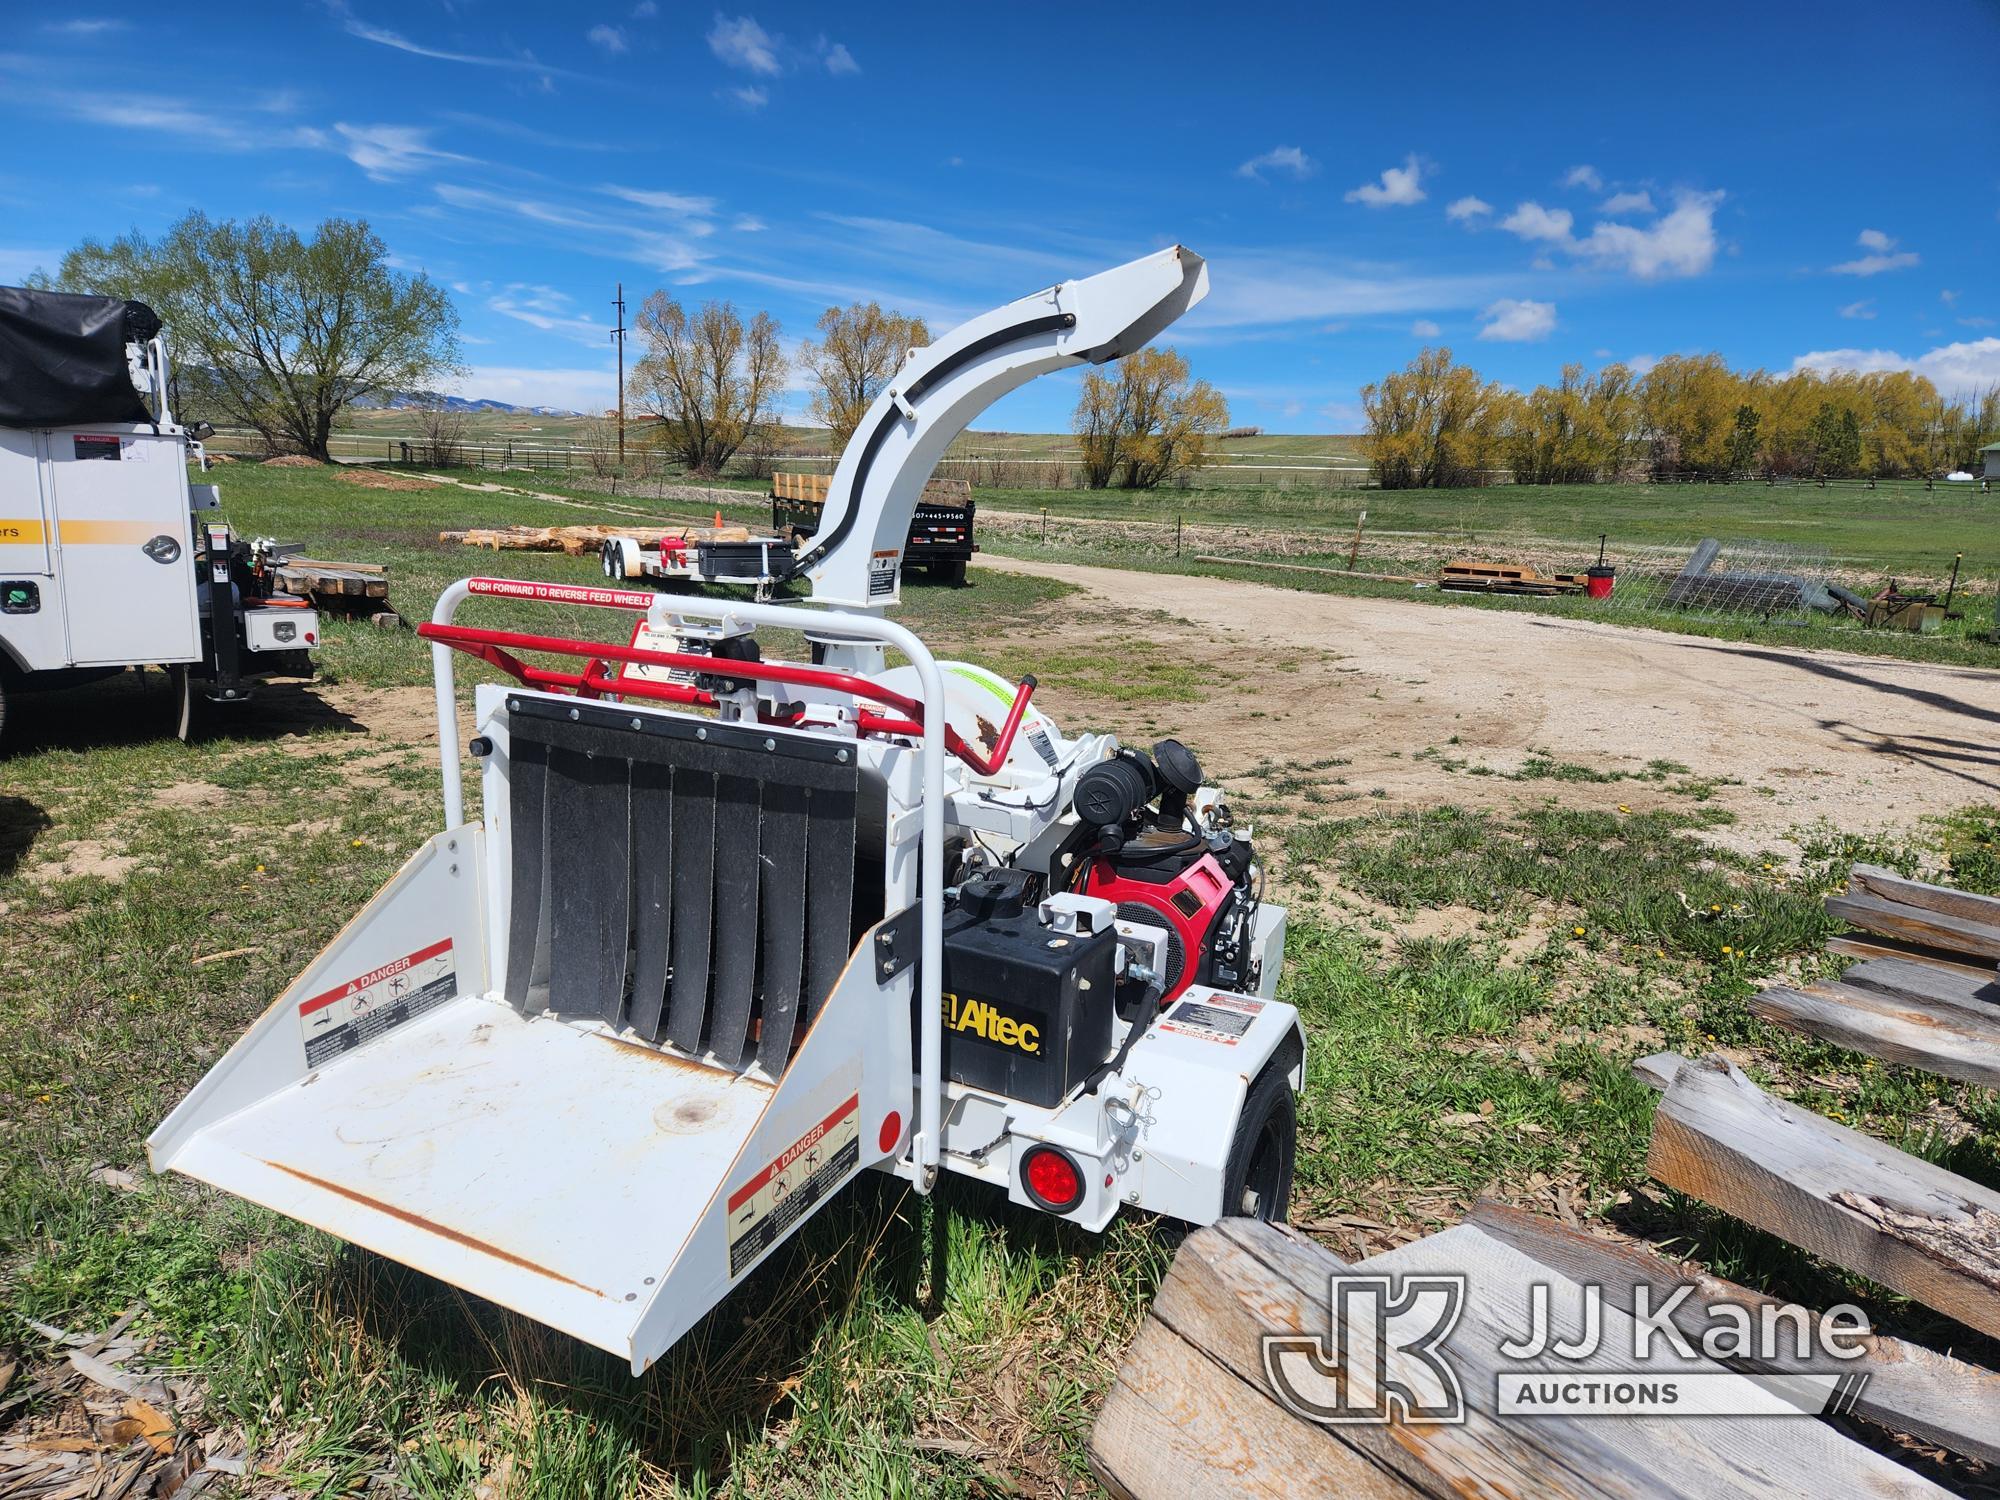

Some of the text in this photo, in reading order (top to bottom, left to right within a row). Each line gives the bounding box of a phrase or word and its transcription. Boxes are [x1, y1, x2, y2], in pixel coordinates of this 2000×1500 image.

[0, 528, 19, 537] rs
[469, 581, 651, 607] PUSH FORWARD TO REVERSE FEED WHEELS
[360, 957, 411, 988] DANGER
[956, 999, 1040, 1053] Altec
[781, 1124, 824, 1168] DANGER
